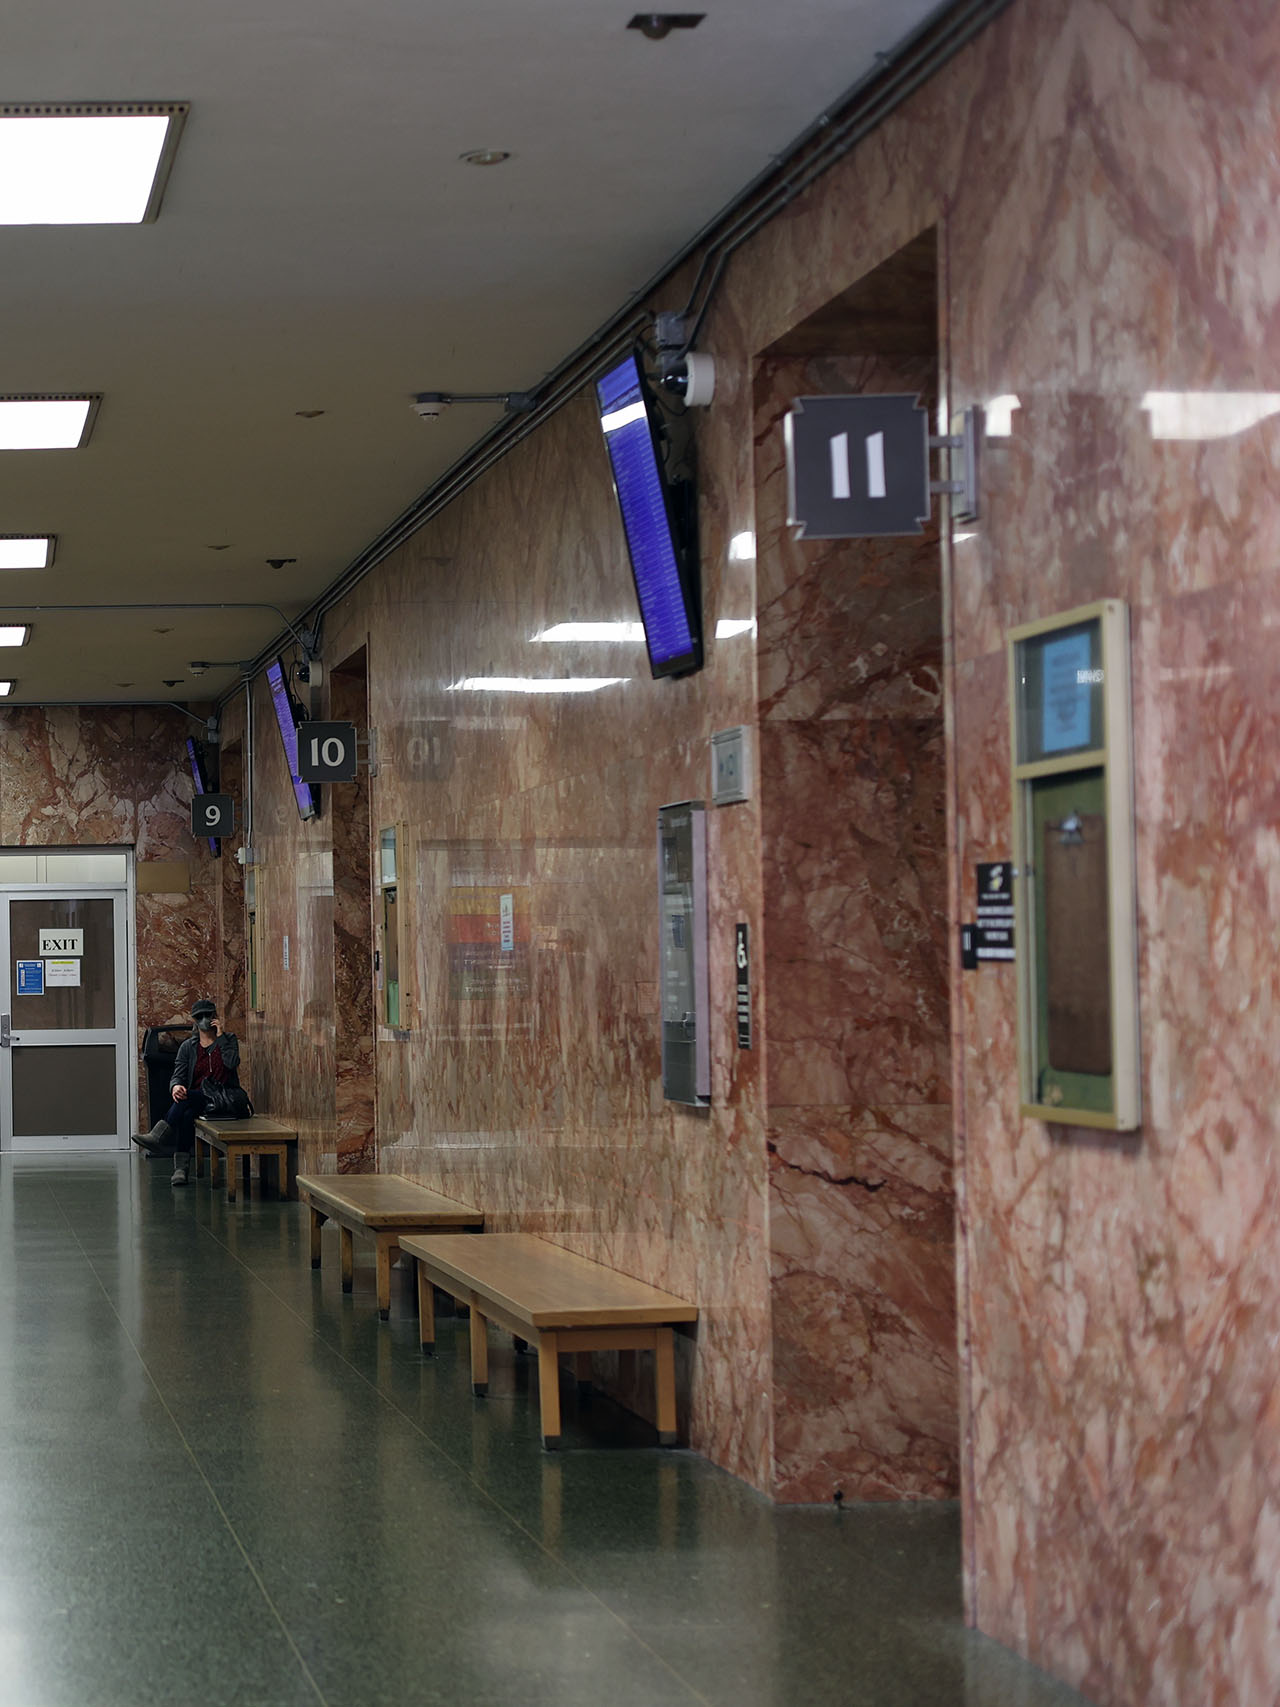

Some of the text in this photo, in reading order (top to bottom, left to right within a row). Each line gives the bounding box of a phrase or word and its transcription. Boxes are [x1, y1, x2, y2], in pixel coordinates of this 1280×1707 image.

[829, 430, 886, 499] 11
[310, 737, 345, 767] 10
[205, 805, 221, 827] 9
[42, 939, 78, 950] EXIT
